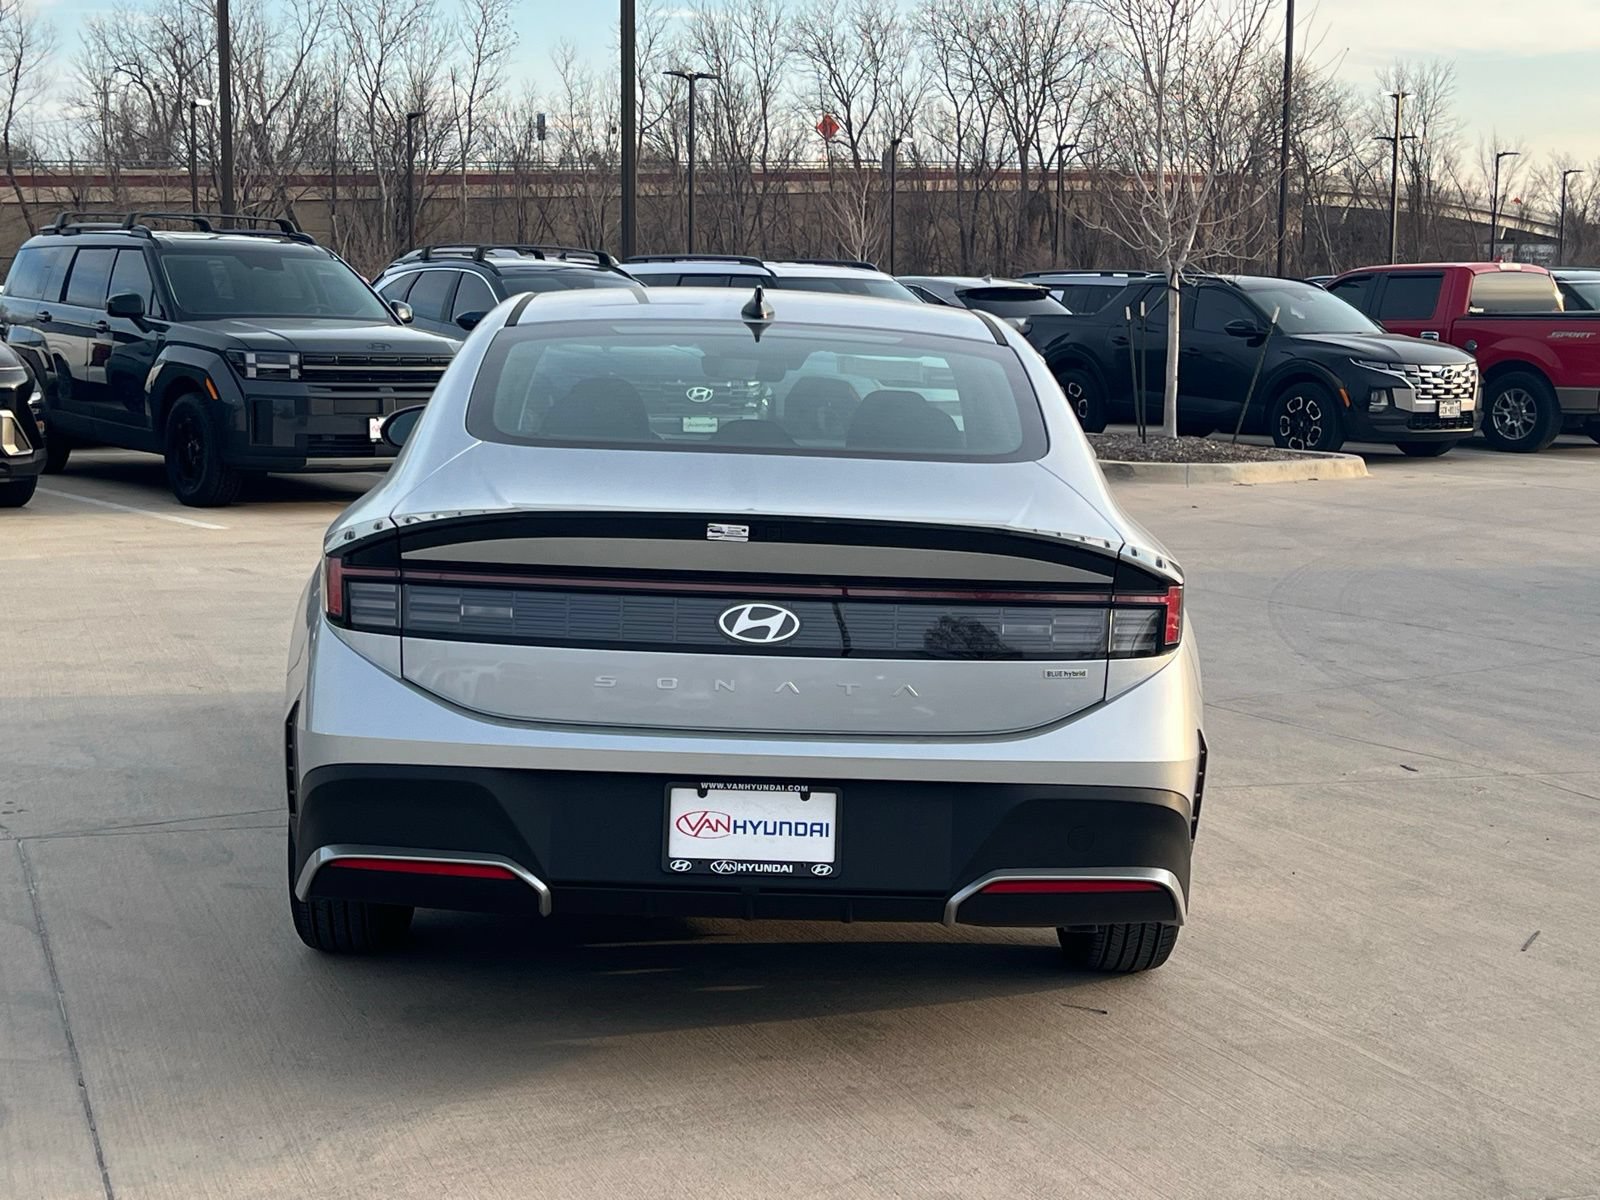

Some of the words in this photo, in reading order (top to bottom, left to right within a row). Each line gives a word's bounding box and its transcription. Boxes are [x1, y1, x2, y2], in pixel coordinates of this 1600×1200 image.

[1547, 331, 1597, 339] SPORT
[1064, 670, 1086, 679] hybrid
[593, 675, 919, 697] SONATA
[700, 782, 809, 792] WWW.VANHYUNDAI.COM
[733, 819, 829, 838] HYUNDAI
